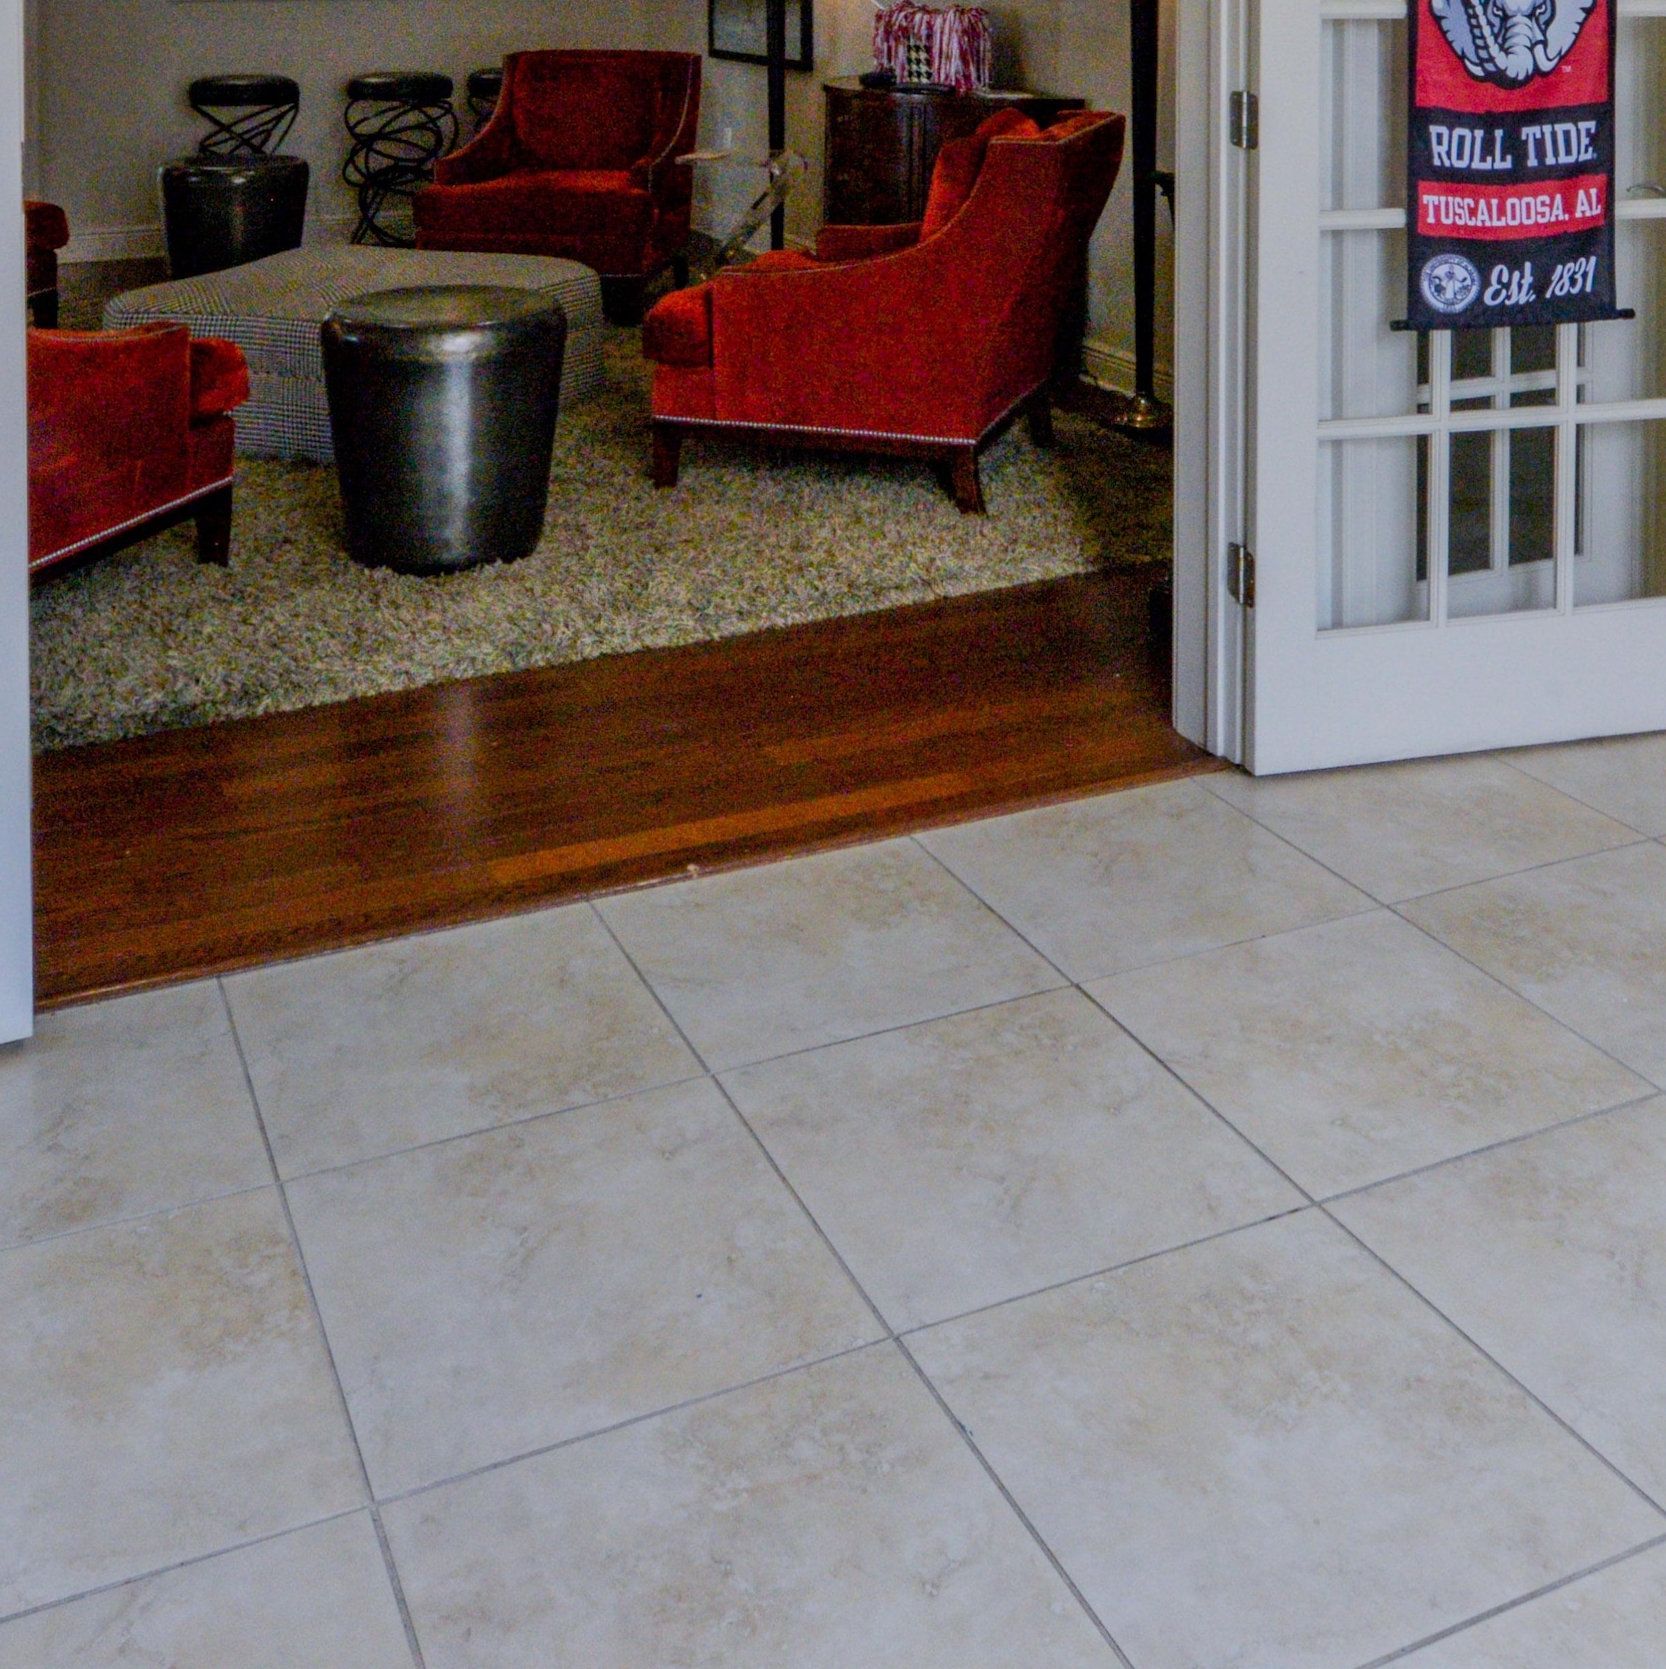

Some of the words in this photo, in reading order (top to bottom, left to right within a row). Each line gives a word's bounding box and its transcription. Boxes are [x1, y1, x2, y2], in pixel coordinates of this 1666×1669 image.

[1429, 125, 1512, 170] ROLL
[1522, 120, 1596, 167] TIDE
[1575, 187, 1601, 218] AL
[1483, 261, 1536, 306] Est.
[1545, 256, 1597, 299] 1831
